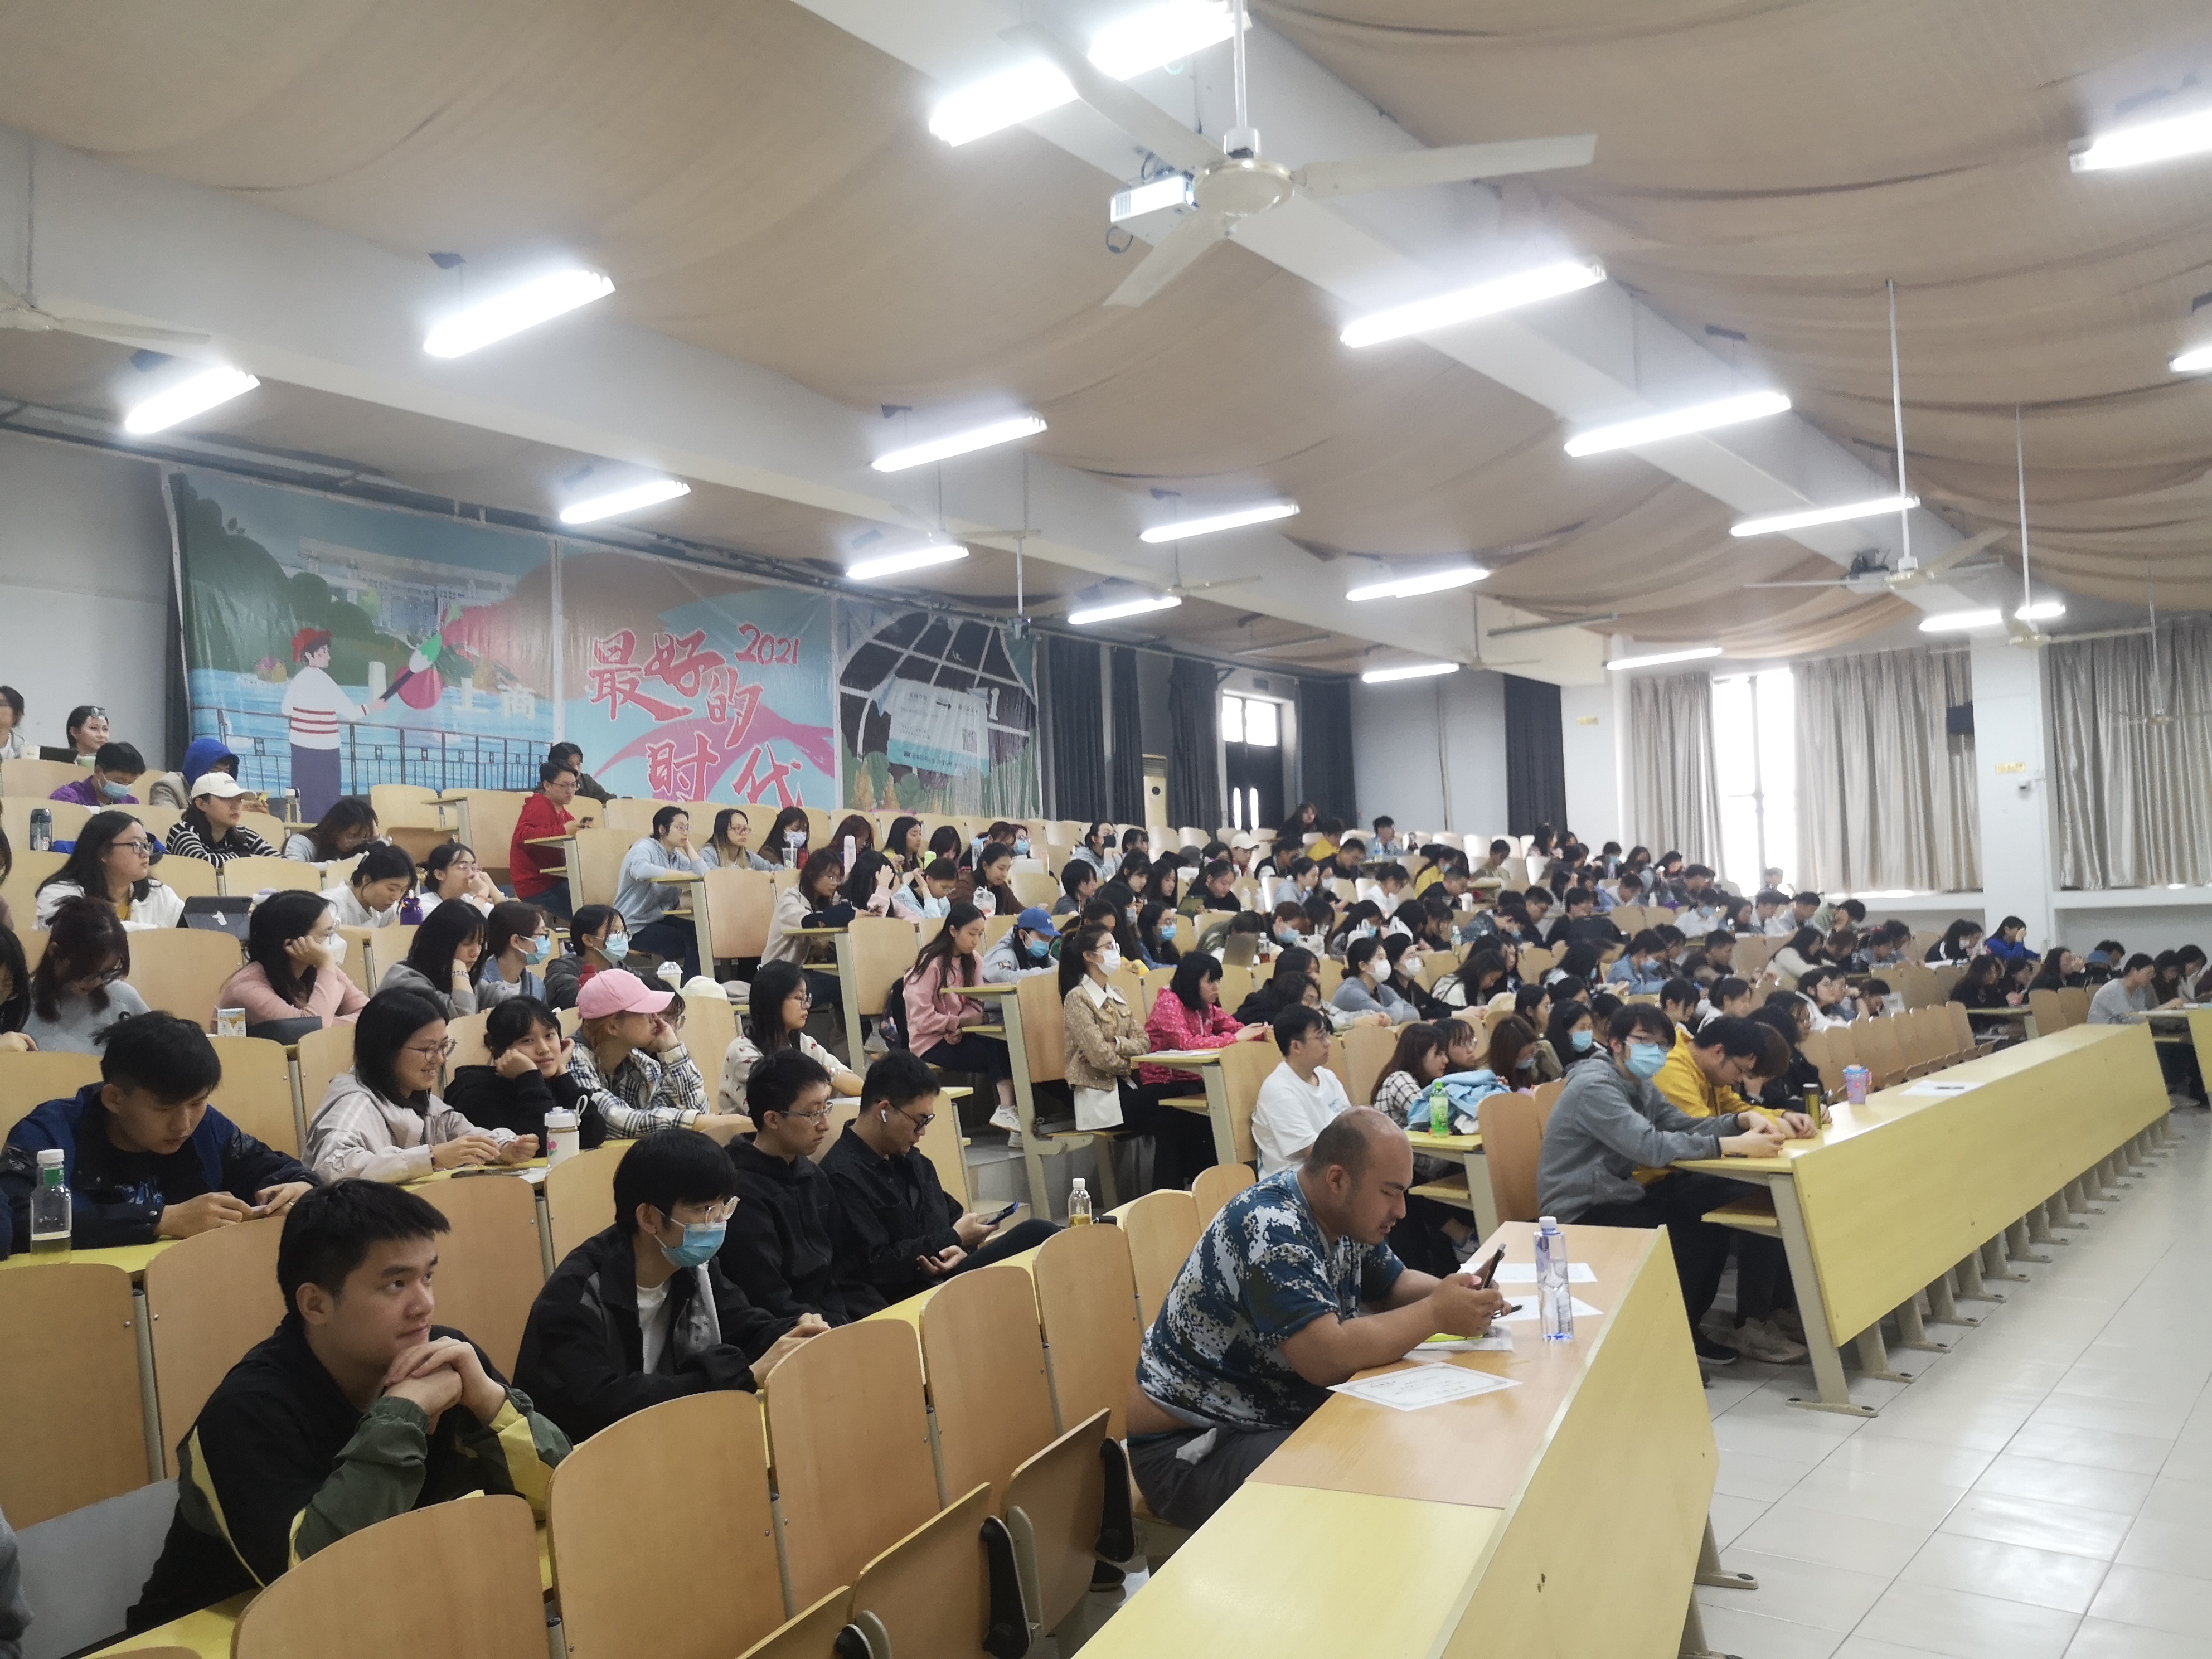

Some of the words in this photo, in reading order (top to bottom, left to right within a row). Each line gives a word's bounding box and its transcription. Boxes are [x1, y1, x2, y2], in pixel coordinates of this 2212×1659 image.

[735, 623, 799, 665] 2021
[589, 628, 763, 749] 最好的
[646, 731, 803, 809] 时代
